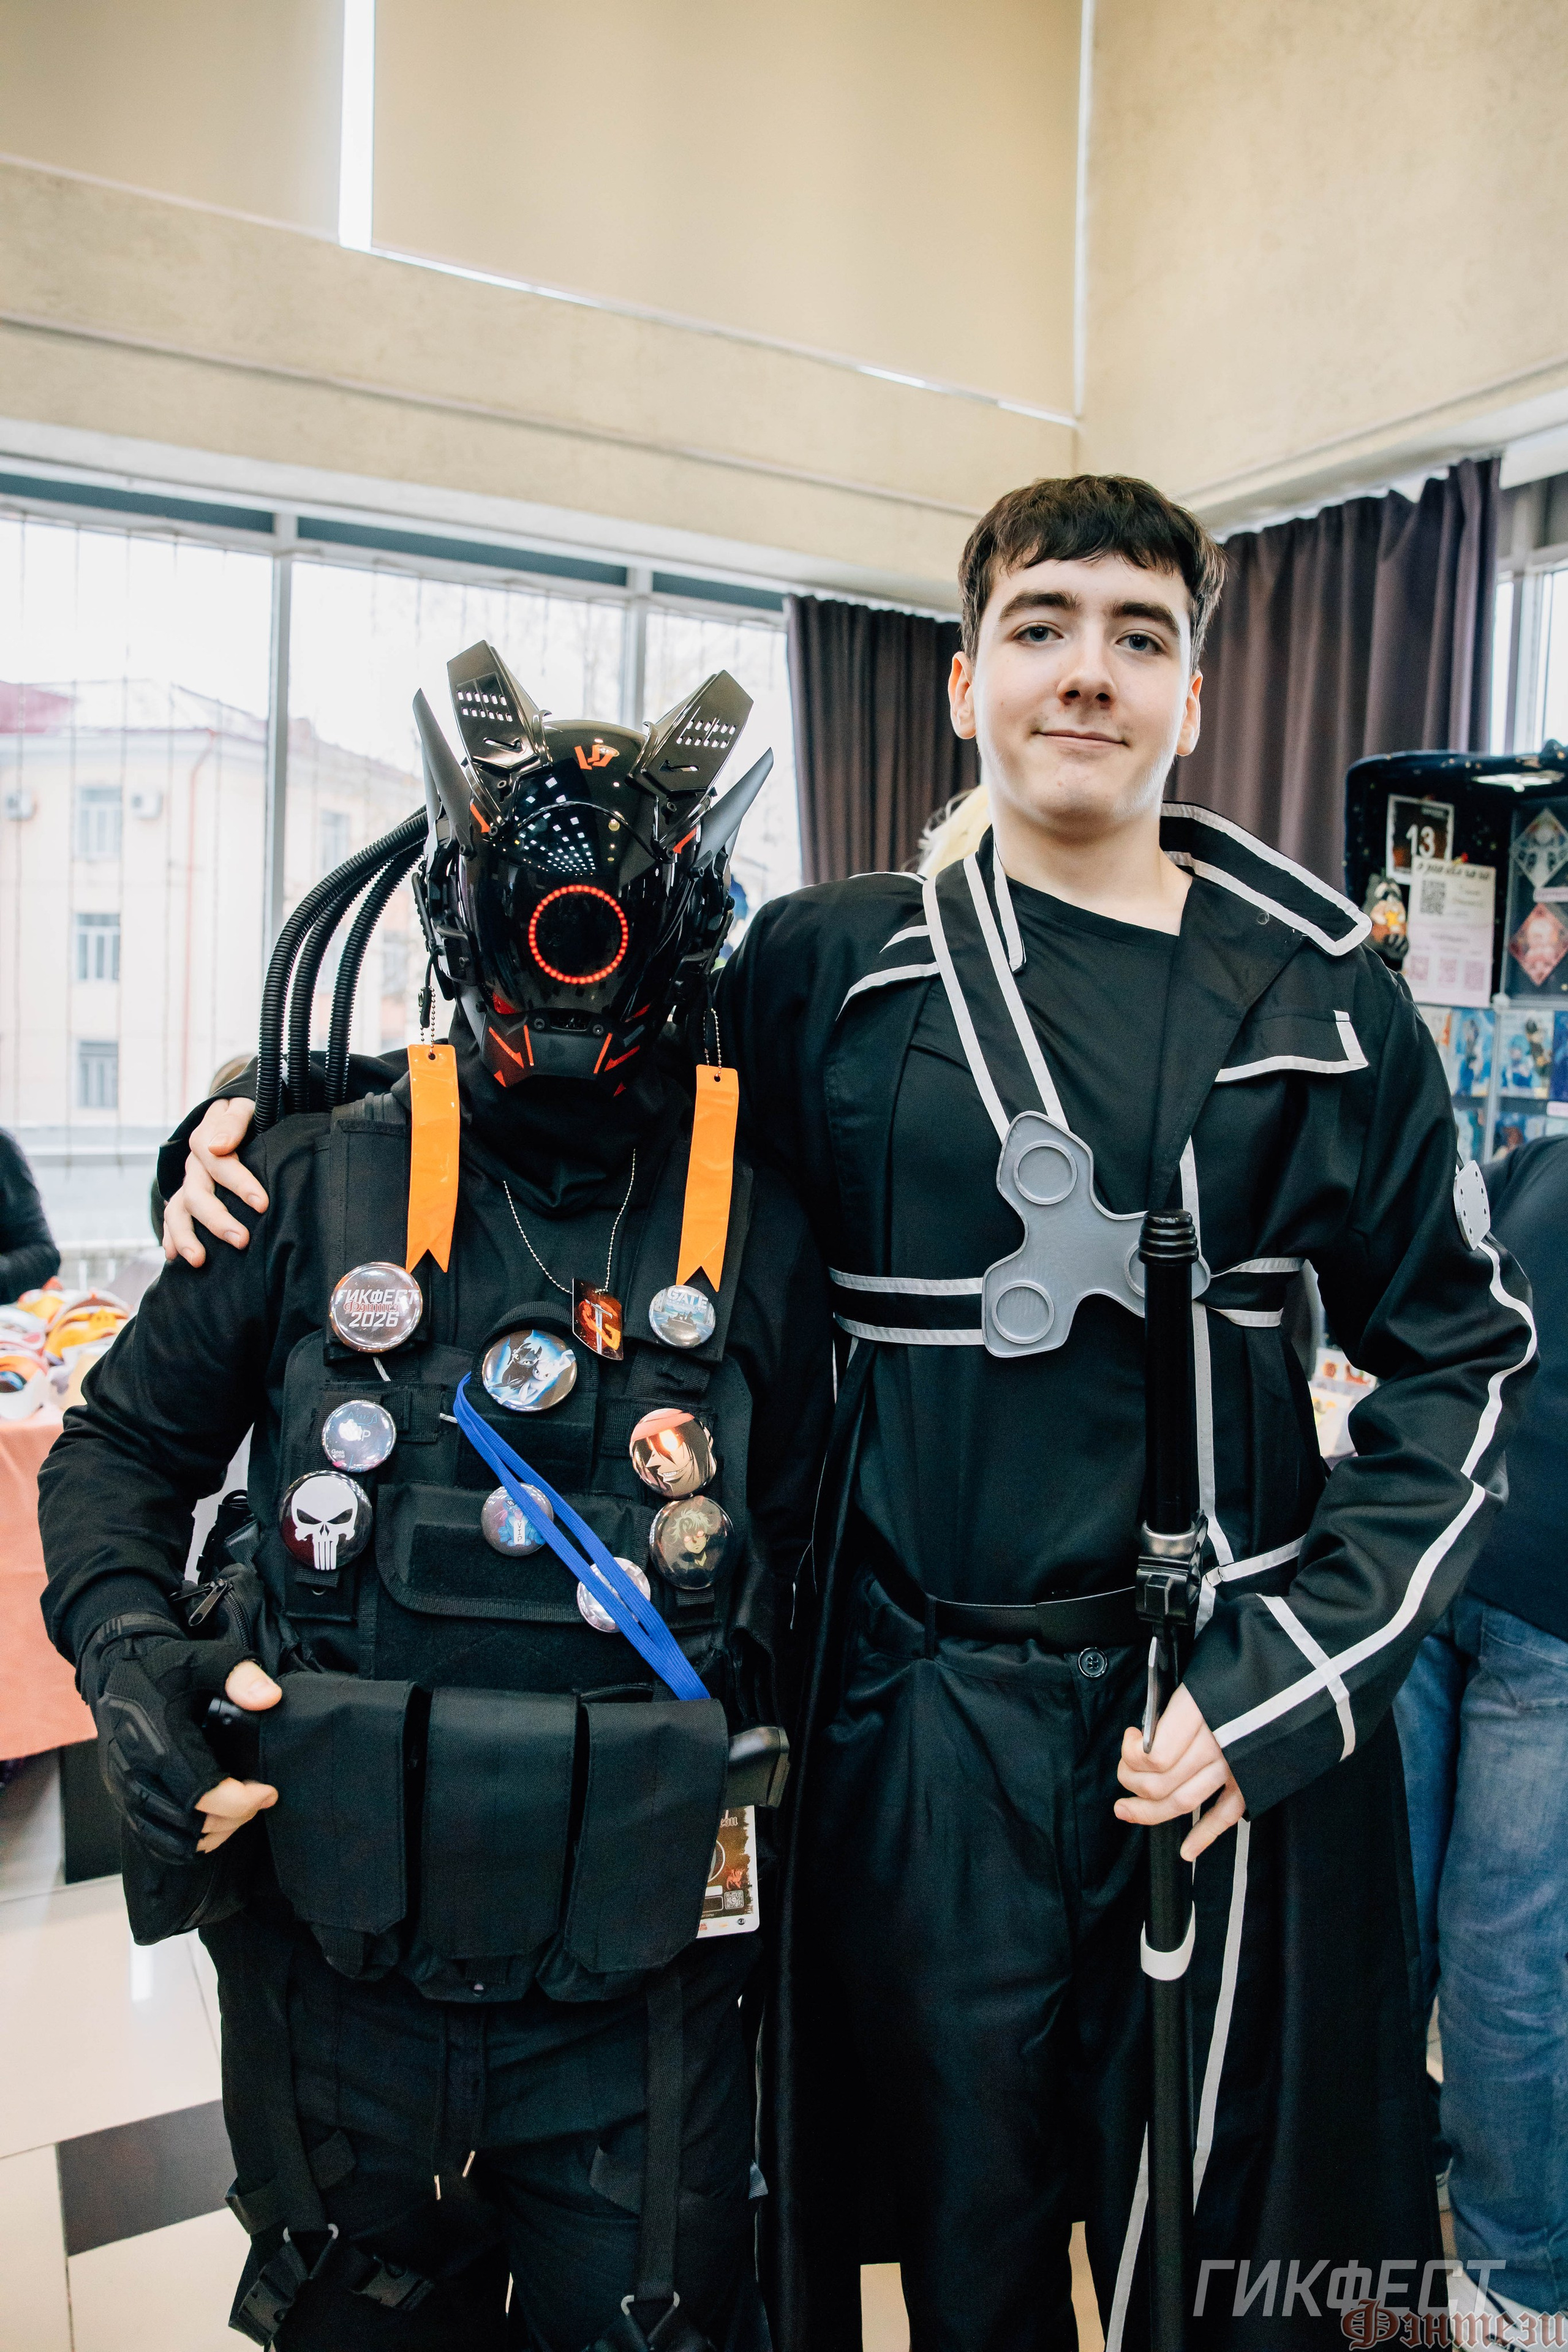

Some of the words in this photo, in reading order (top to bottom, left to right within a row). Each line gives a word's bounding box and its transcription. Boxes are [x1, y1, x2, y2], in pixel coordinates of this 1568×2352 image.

[1405, 824, 1436, 858] 13
[335, 1289, 420, 1305] ГИКФЕСТ
[667, 1287, 709, 1310] GATE
[349, 1311, 400, 1328] 2026
